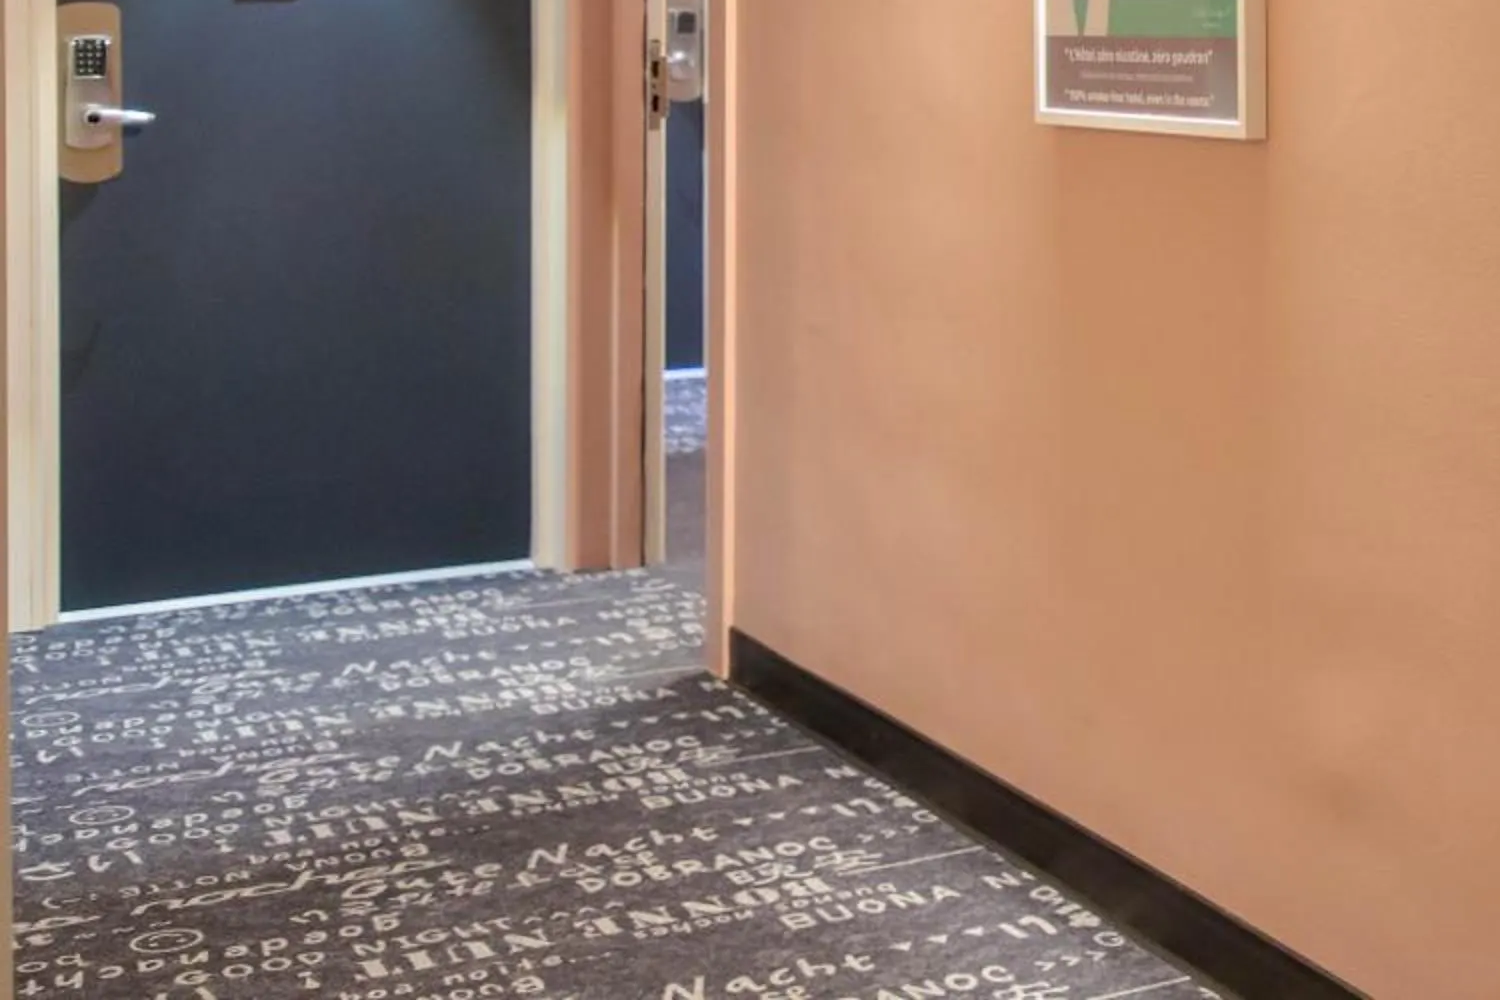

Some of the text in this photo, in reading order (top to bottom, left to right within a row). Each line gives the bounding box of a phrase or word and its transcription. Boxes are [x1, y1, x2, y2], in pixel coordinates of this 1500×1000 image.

[424, 730, 594, 761] Nacht
[467, 736, 700, 779] DOBRANOC
[641, 776, 801, 809] BUONA
[342, 828, 717, 898] Gute Nacht
[576, 837, 836, 892] DOBRANOC
[780, 886, 960, 930] BUONA
[174, 917, 510, 985] GOOD NIGHT
